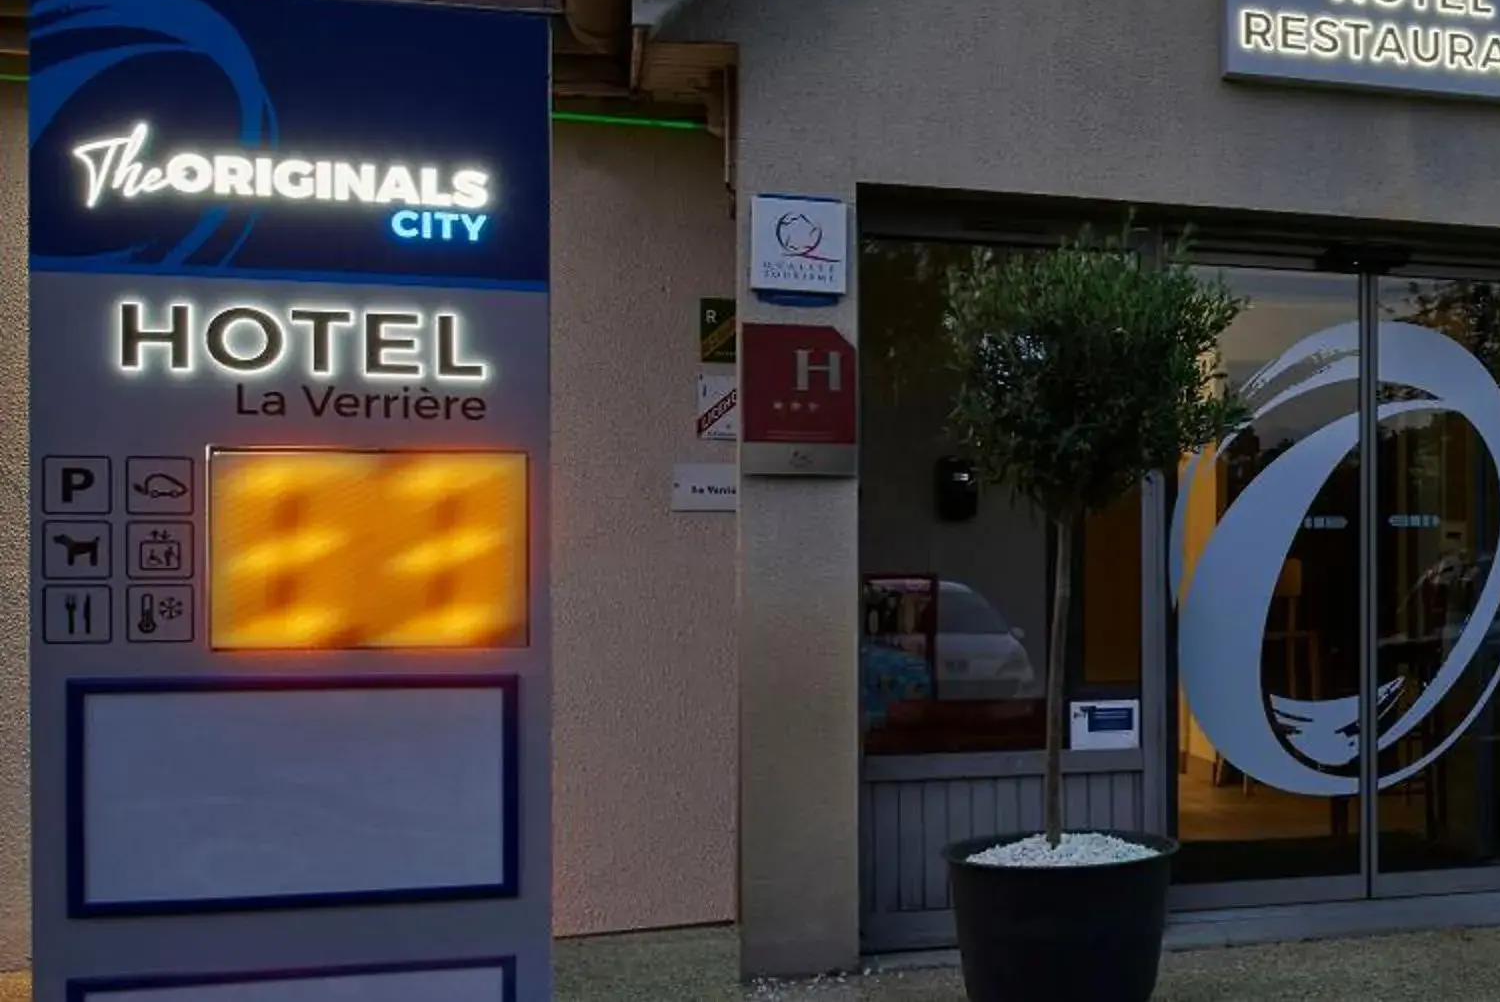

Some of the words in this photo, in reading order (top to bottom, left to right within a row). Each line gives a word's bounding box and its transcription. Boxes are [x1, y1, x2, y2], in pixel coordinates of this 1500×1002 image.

[167, 152, 491, 208] ORIGINALS
[390, 209, 489, 242] CITY
[117, 301, 491, 379] HOTEL
[792, 349, 842, 391] H
[235, 384, 286, 417] La
[301, 385, 488, 422] Verrière
[61, 467, 95, 502] P
